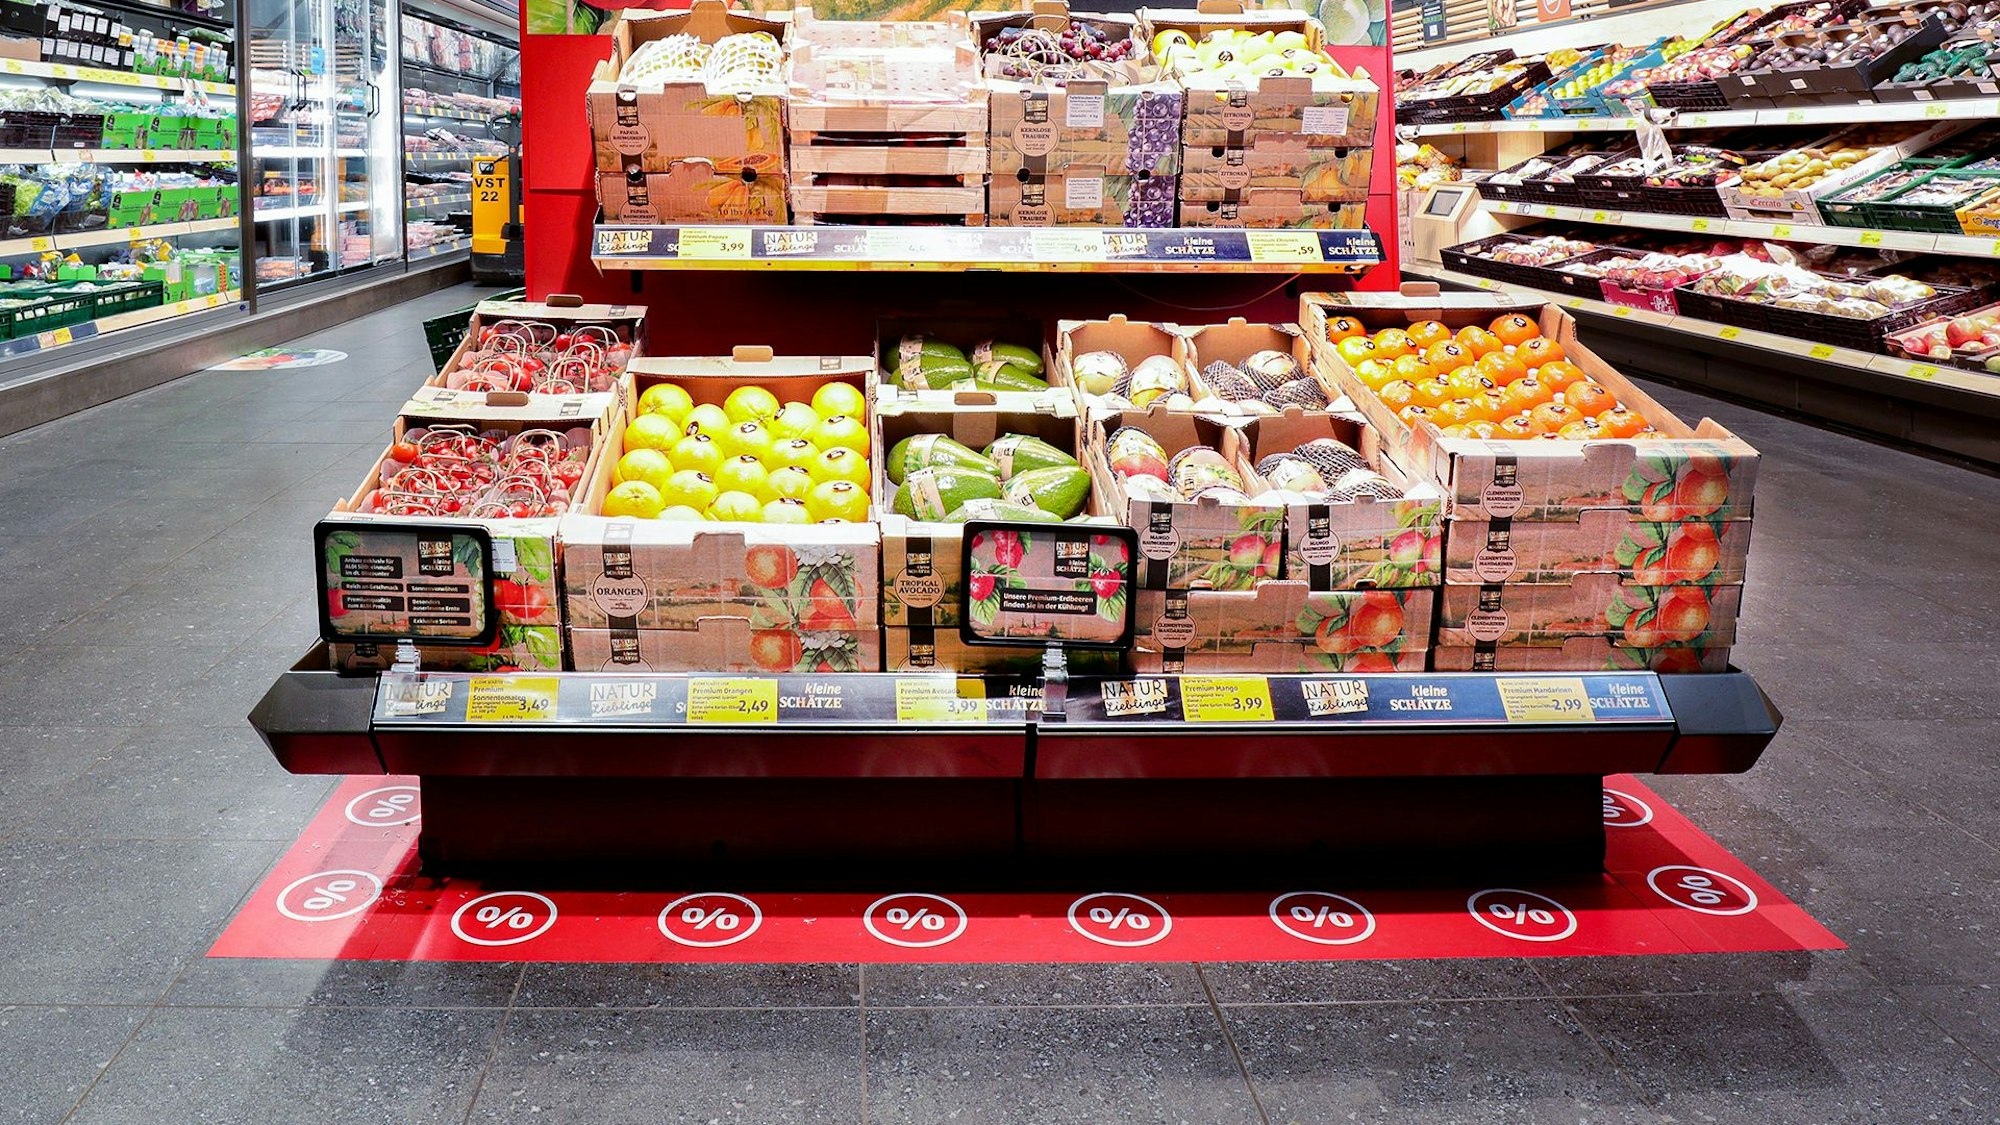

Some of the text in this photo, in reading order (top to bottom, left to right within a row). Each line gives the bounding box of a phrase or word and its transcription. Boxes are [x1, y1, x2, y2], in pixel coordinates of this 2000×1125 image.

[474, 177, 506, 188] VST
[480, 190, 499, 202] 22
[1750, 198, 1782, 208] Cerrato
[600, 231, 650, 243] NATUR
[766, 231, 817, 243] NATUR
[1183, 236, 1214, 246] kleine
[1346, 237, 1376, 247] kleine
[720, 242, 745, 252] 3,99
[1165, 244, 1216, 255] SCHÄTZE
[1328, 245, 1380, 256] SCHÄTZE
[420, 541, 452, 550] NATUR
[1056, 541, 1089, 550] NATUR
[421, 564, 452, 572] SCHÄTZE
[1056, 565, 1087, 573] SCHÄTZE
[596, 587, 644, 596] ORANGEN
[1003, 592, 1093, 603] Unsere Premium-Erdbeeren
[1057, 602, 1089, 612] Kühlung!
[593, 684, 654, 700] NATUR
[804, 683, 842, 695] kleine
[1008, 684, 1045, 697] kleine
[1104, 681, 1163, 698] NATUR
[1216, 685, 1239, 693] Mango
[1304, 681, 1365, 699] NATUR
[1411, 685, 1448, 697] kleine
[1607, 684, 1645, 696] kleine
[518, 698, 549, 713] 3,49
[592, 701, 652, 714] Lieblinge
[738, 699, 769, 714] 2,49
[779, 694, 842, 709] SCHÄTZE
[948, 700, 978, 714] 3,99
[985, 695, 1047, 711] SCHÄTZE
[1106, 698, 1165, 712] Lieblinge
[1232, 697, 1263, 712] 3,99
[1307, 698, 1368, 712] Lieblinge
[1389, 696, 1453, 711] SCHÄTZE
[1551, 698, 1582, 712] 2,99
[1588, 696, 1651, 709] SCHÄTZE
